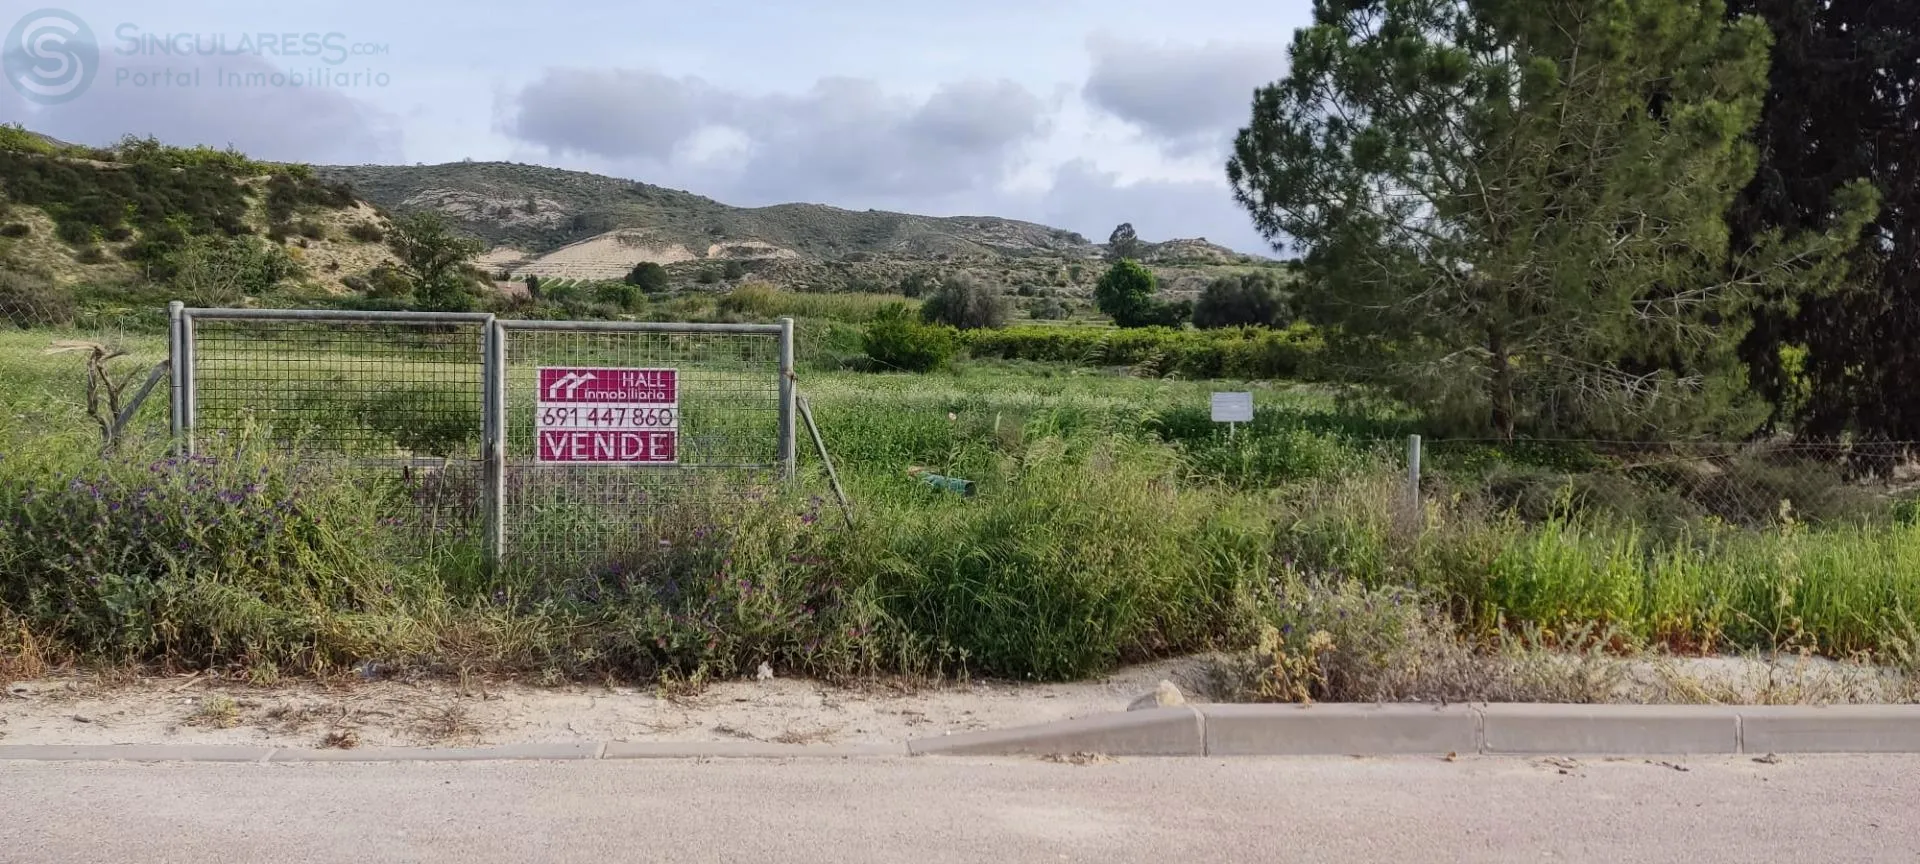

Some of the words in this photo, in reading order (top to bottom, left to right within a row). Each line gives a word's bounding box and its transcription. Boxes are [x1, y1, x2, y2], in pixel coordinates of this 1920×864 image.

[622, 372, 666, 387] HALL
[542, 407, 578, 426] 691
[588, 407, 626, 426] 447
[632, 407, 673, 426] 860
[545, 433, 668, 459] VENDE
